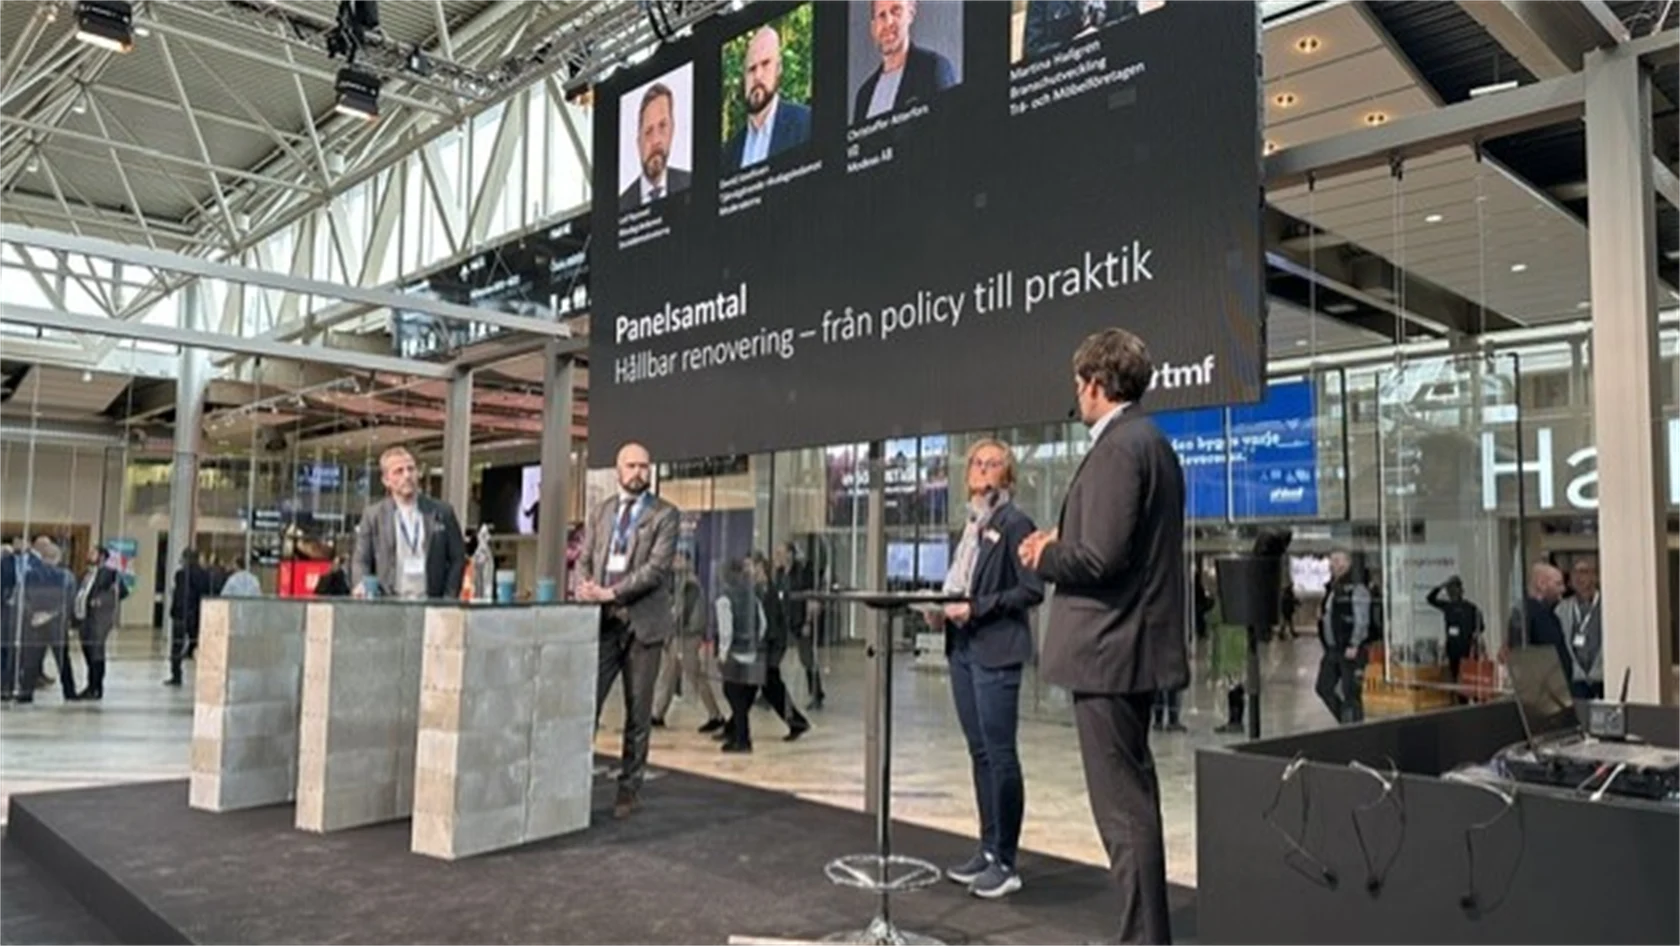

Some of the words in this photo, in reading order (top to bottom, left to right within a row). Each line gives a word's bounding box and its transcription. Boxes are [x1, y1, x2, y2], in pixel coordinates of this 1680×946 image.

[614, 349, 678, 384] Hållbar
[681, 327, 796, 359] renovering
[821, 306, 873, 344] från
[881, 290, 966, 340] policy
[974, 270, 1013, 314] till
[1025, 240, 1154, 313] praktik
[615, 282, 748, 344] Panelsamtal
